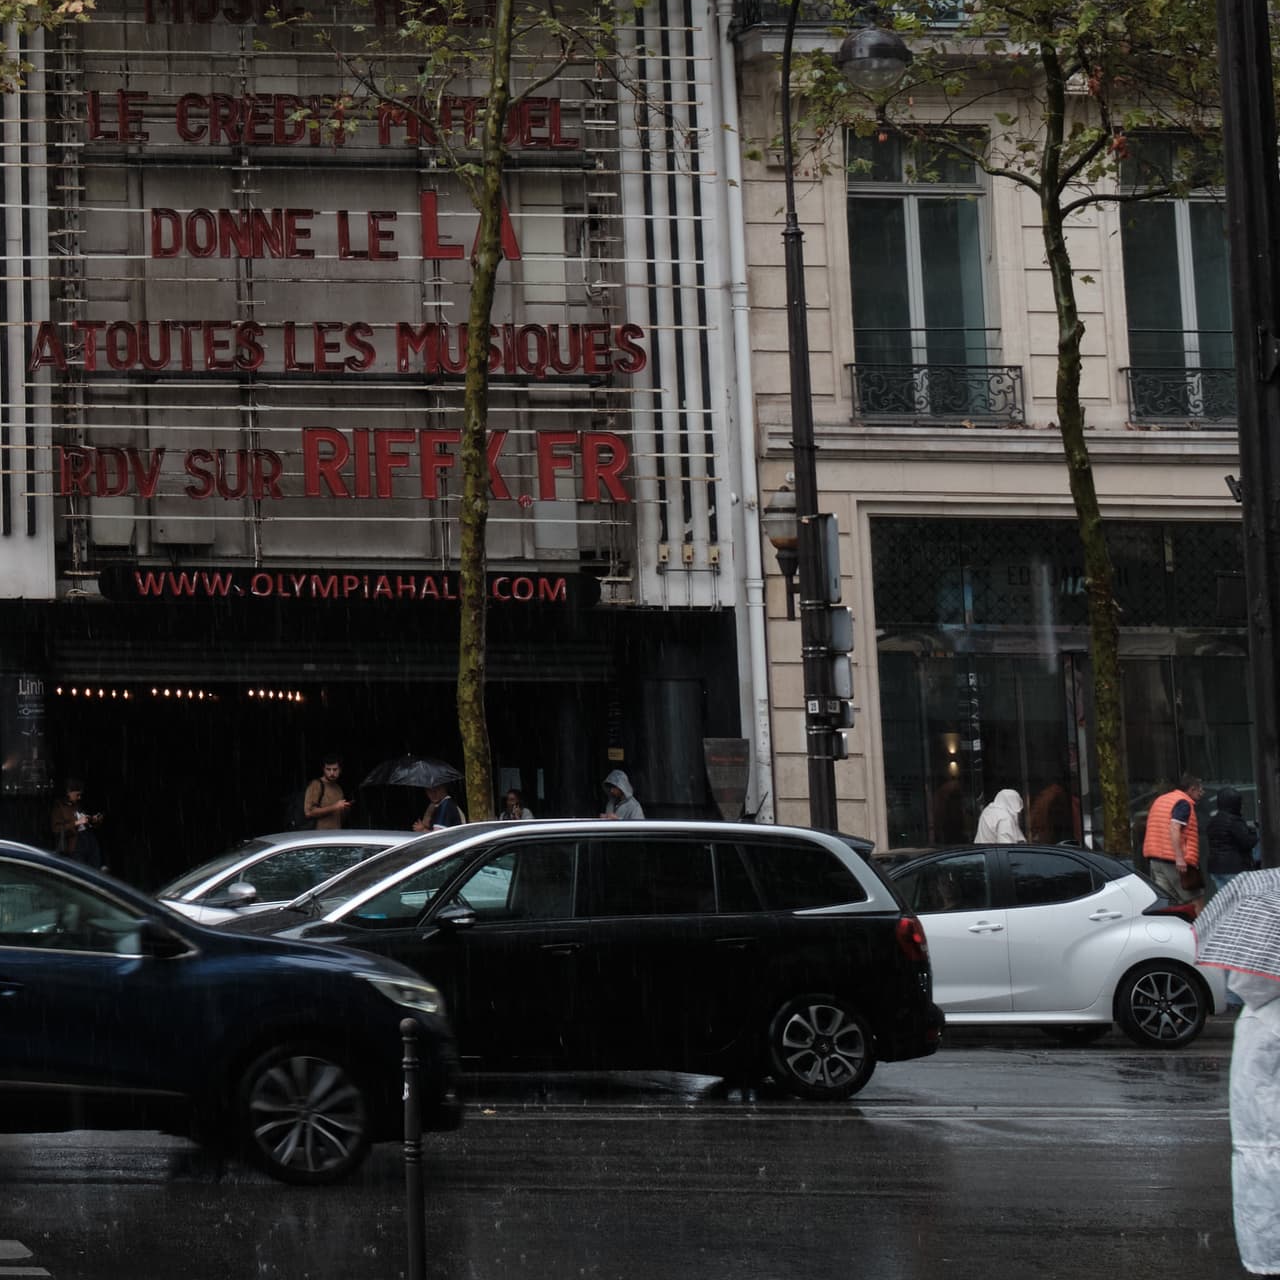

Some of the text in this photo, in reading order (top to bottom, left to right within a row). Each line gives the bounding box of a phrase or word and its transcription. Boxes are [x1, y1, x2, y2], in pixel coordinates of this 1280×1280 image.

[86, 88, 150, 143] LE
[151, 190, 522, 261] DONNE LE LA
[29, 320, 649, 377] A TOUTES LES MUSIQUES
[58, 445, 166, 499] RDV
[184, 447, 282, 501] SUR
[133, 570, 567, 602] WWW.OLYMPIAHAL.COM
